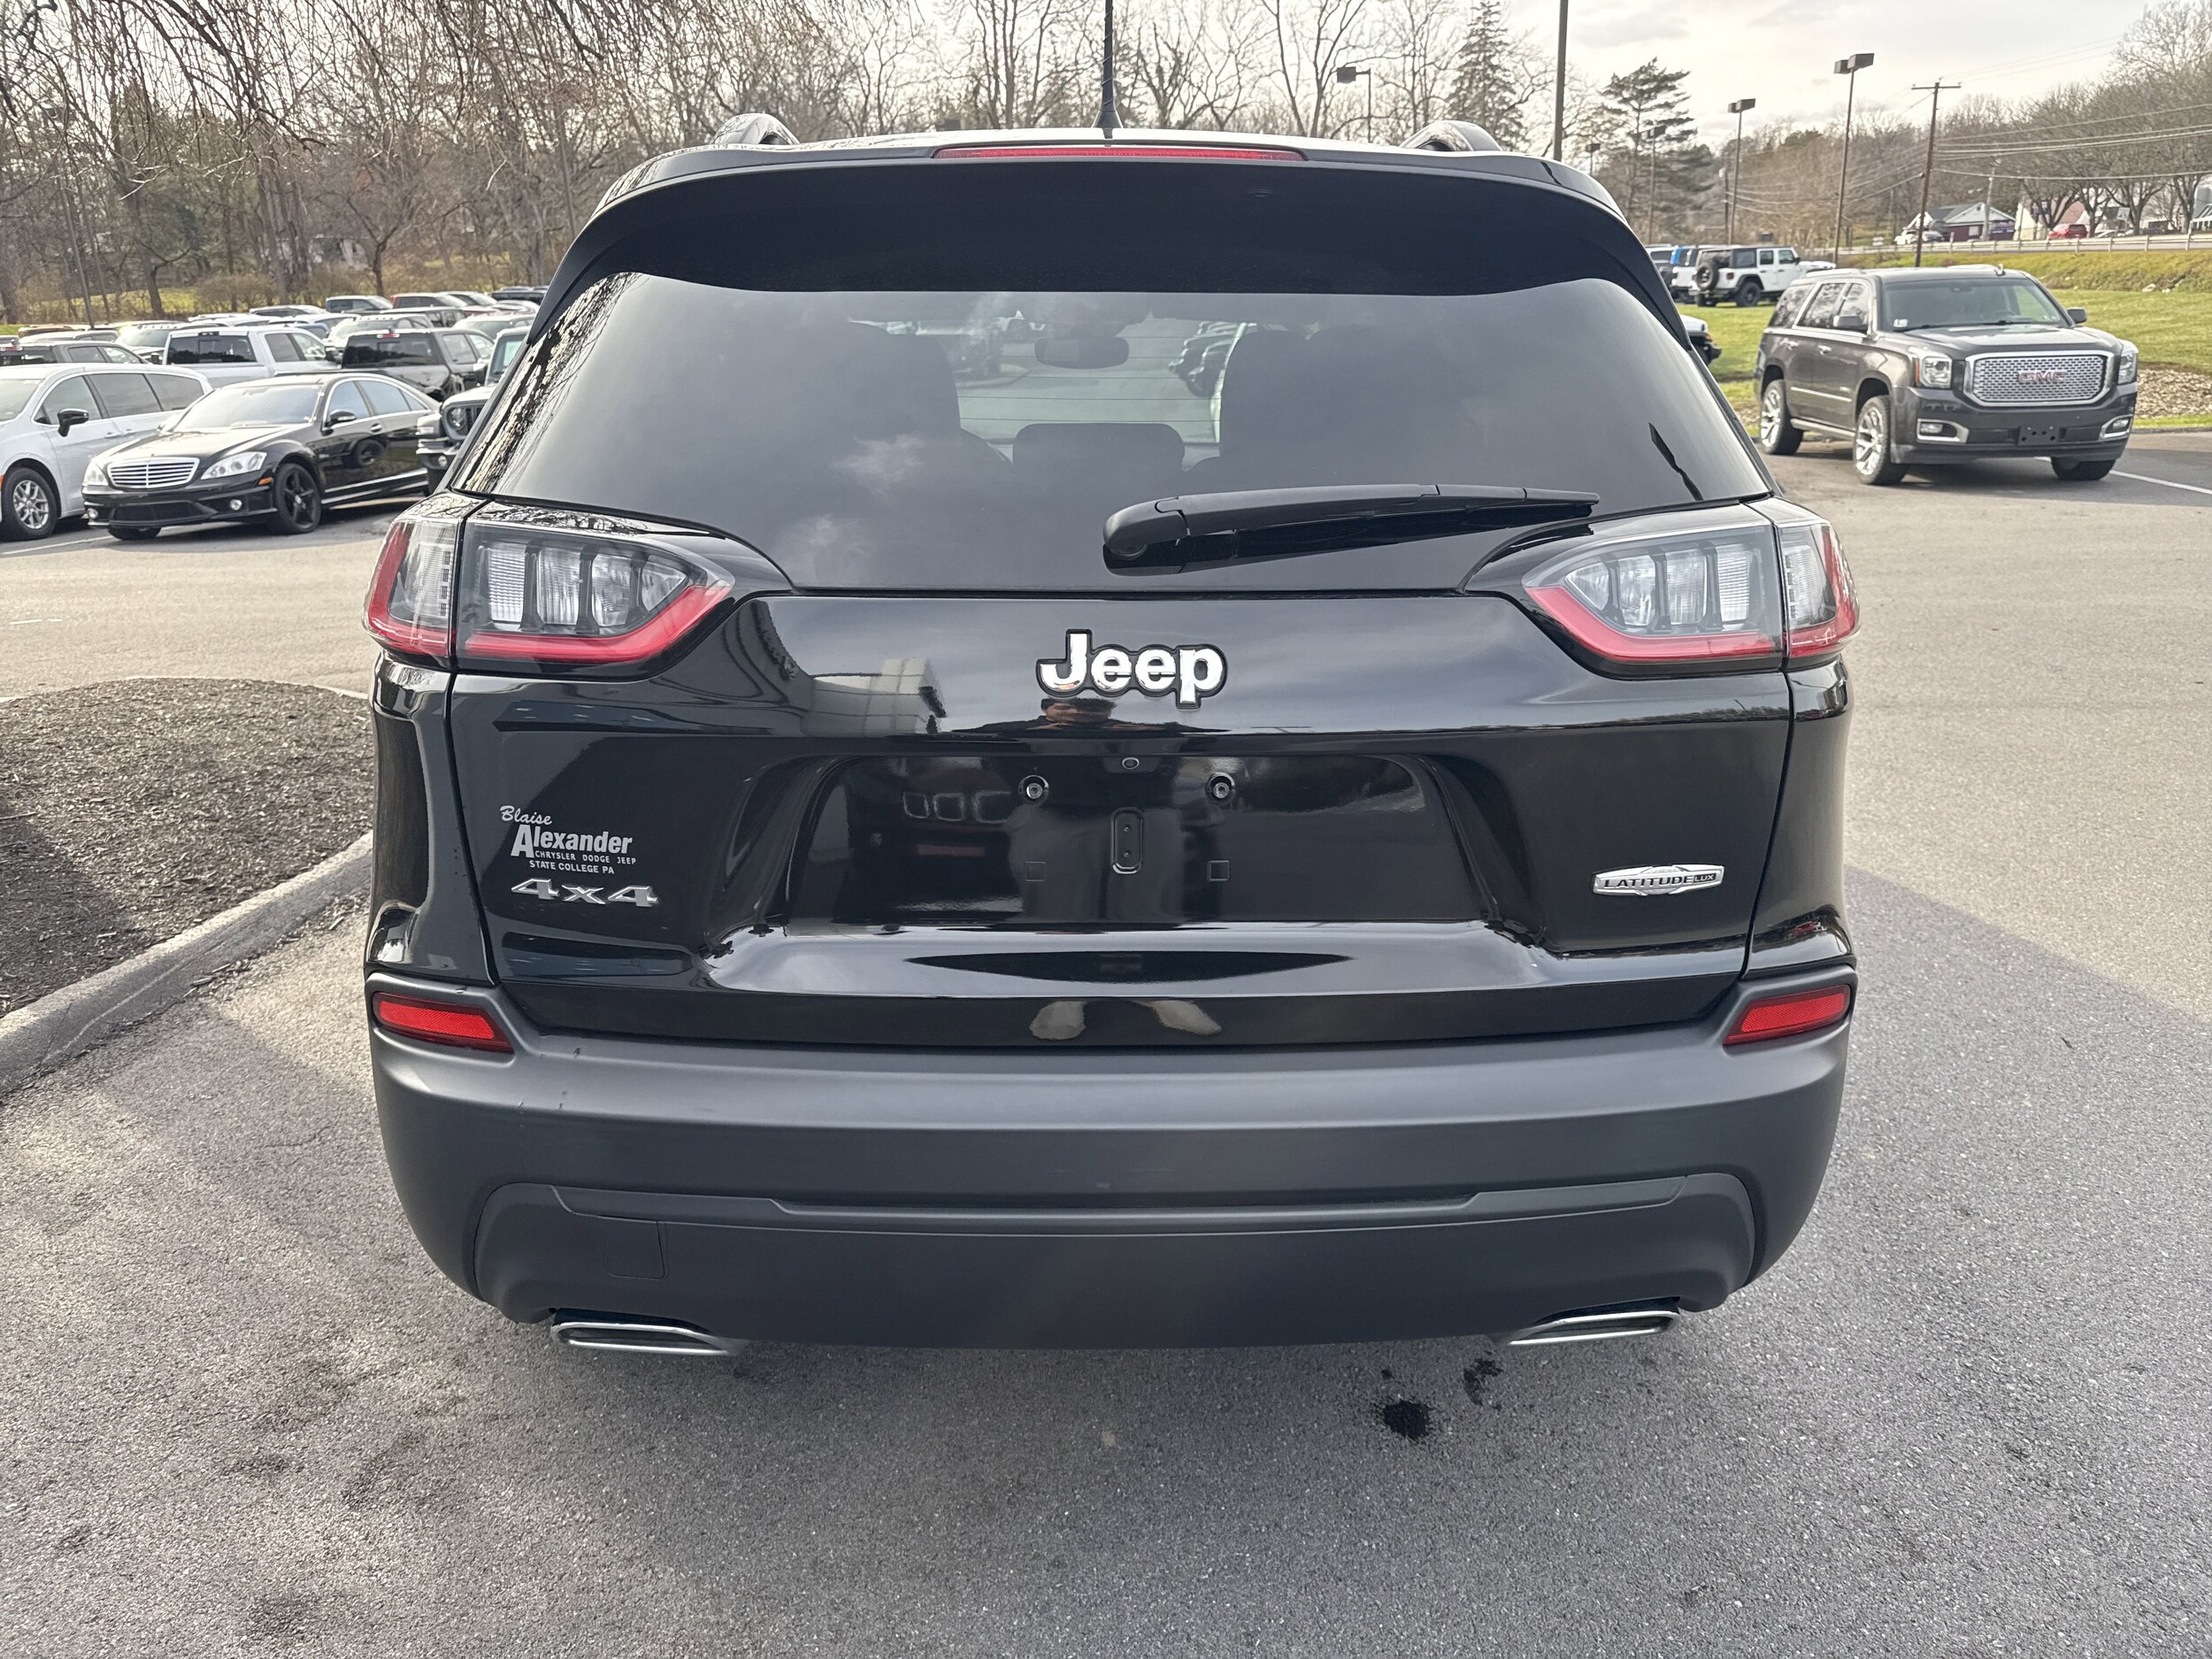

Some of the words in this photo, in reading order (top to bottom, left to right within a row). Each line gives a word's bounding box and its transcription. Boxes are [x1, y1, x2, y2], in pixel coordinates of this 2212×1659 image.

[2018, 371, 2067, 382] GMC
[1037, 629, 1228, 709] Jeep
[500, 805, 552, 826] Blaise
[511, 825, 633, 857] Alexander
[534, 850, 576, 861] CHRYSLER
[582, 854, 610, 864] DODGE
[529, 860, 556, 870] STATE
[558, 863, 599, 873] COLLEGE
[602, 865, 615, 874] PA
[1604, 875, 1694, 888] LATITUDE
[1694, 873, 1717, 883] LUX
